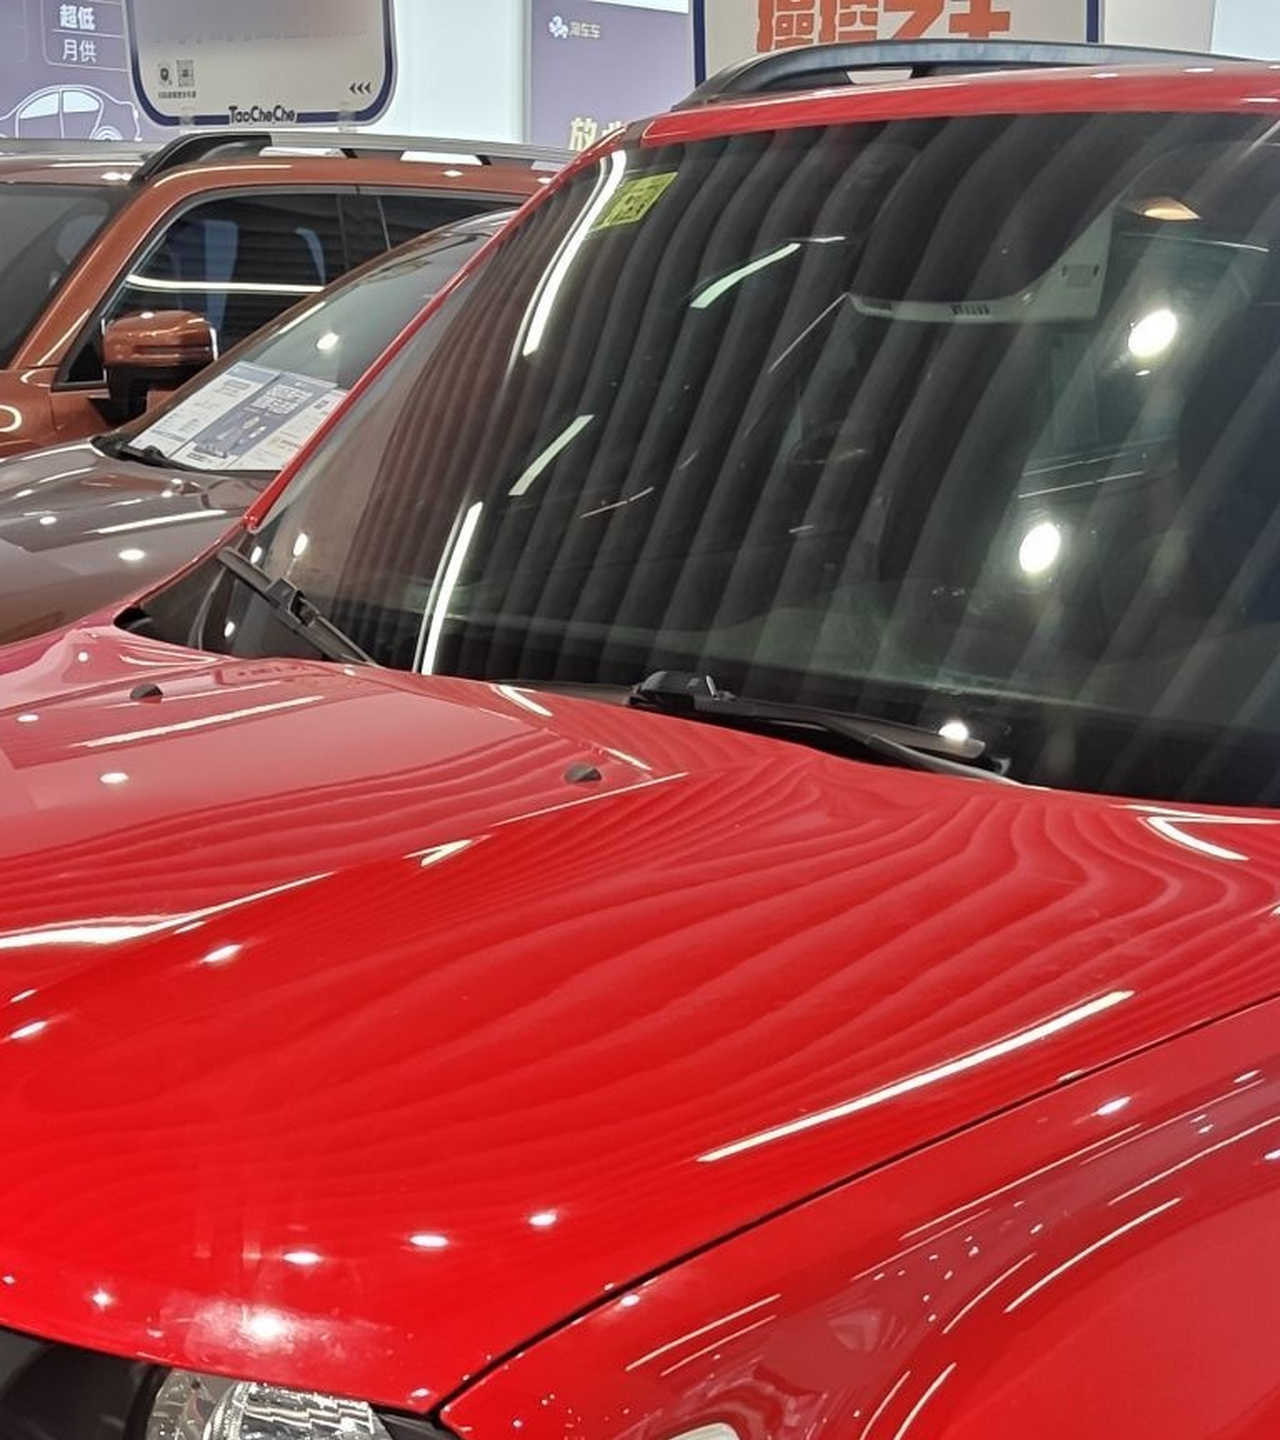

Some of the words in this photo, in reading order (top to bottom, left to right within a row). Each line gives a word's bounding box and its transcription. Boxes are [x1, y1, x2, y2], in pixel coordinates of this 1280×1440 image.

[59, 4, 95, 30] 超低
[62, 39, 97, 63] 月供
[228, 105, 296, 123] TaoCheChe
